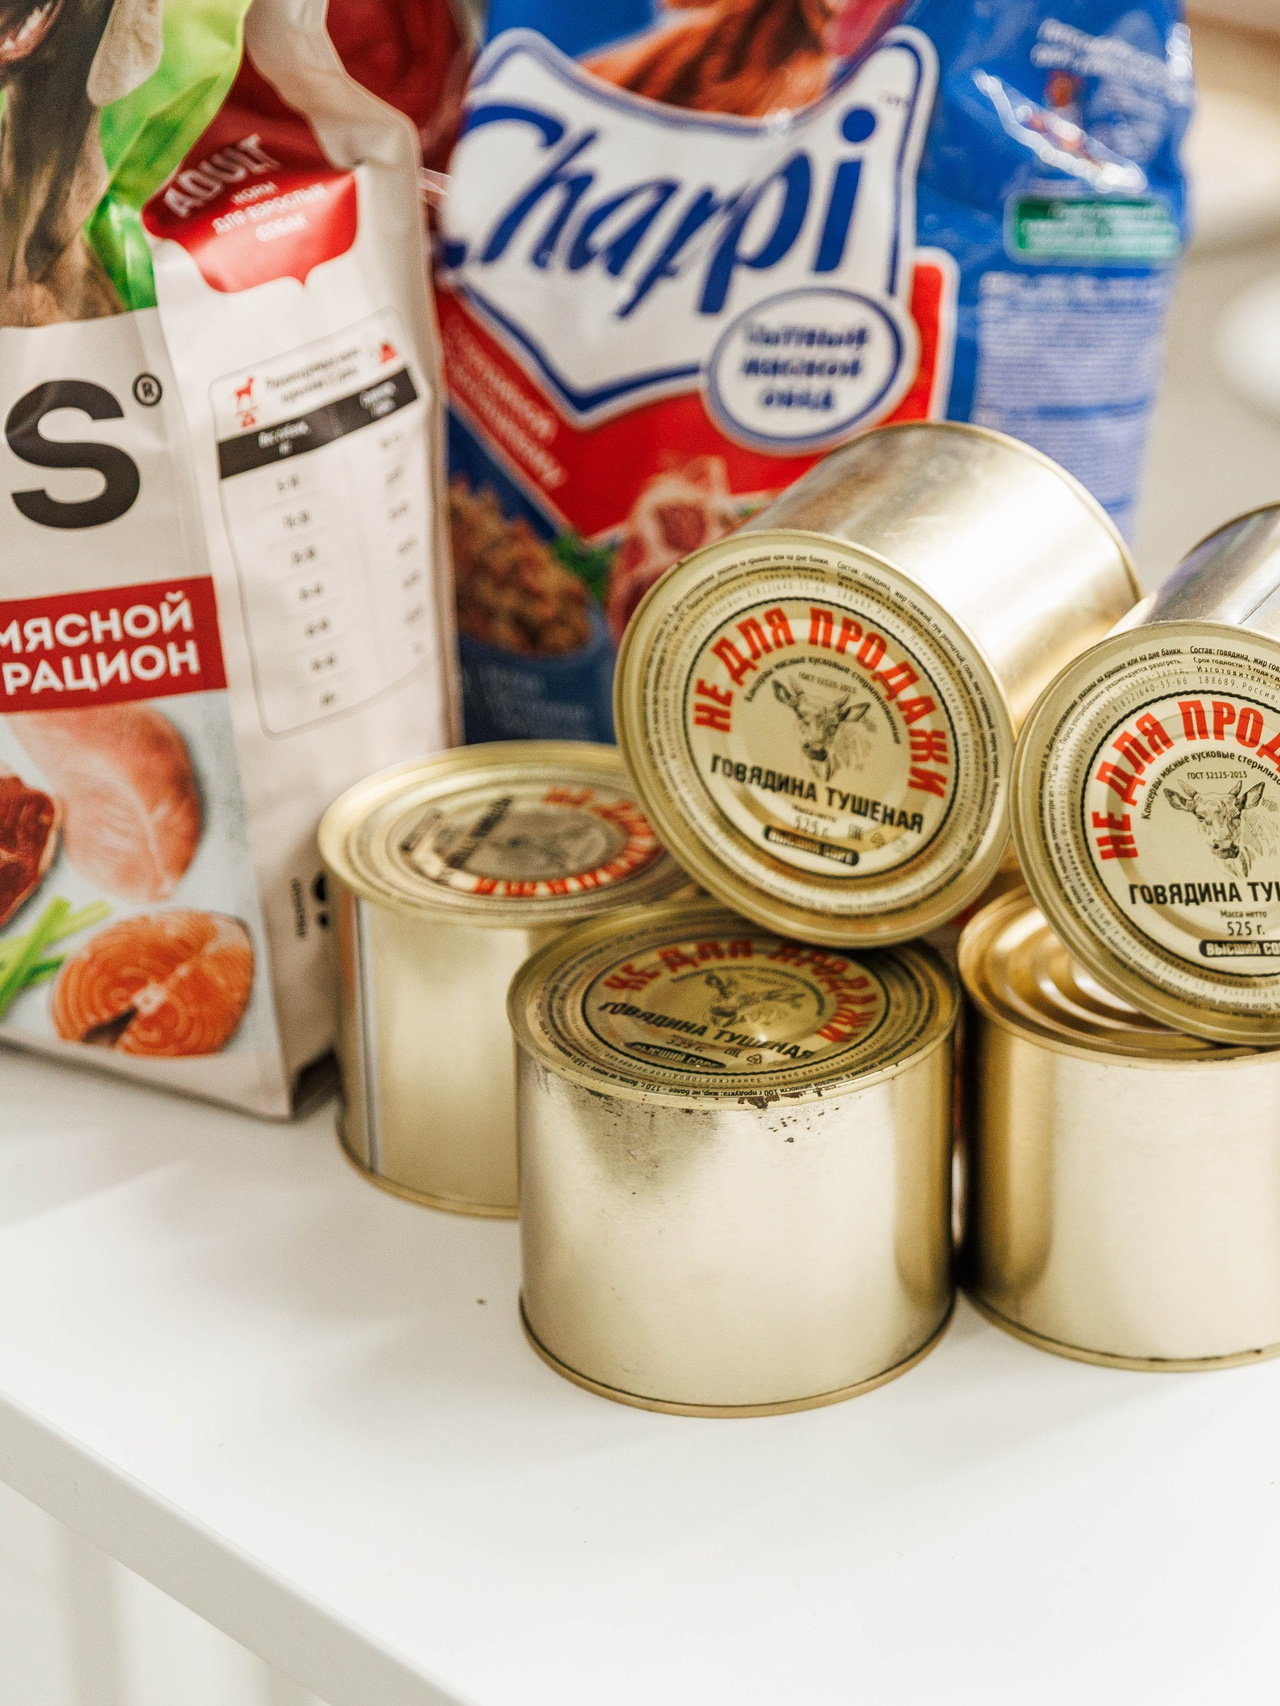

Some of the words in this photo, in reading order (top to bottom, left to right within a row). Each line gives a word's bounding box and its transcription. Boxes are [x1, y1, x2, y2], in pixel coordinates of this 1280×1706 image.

[0, 591, 194, 655] МЯСНОЙ
[712, 606, 796, 686] ДЛЯ
[1188, 645, 1215, 654] Состав:
[1216, 648, 1250, 662] говядина,
[1252, 656, 1267, 668] жир
[2, 640, 199, 696] РАЦИОН
[1101, 661, 1128, 680] крышке
[1125, 657, 1138, 666] или
[1137, 653, 1147, 661] на
[1146, 650, 1161, 660] дне
[1159, 645, 1183, 656] банки.
[1147, 658, 1183, 671] разогреть.
[1192, 656, 1209, 664] Срок
[1211, 658, 1245, 669] годности:
[1253, 667, 1269, 677] года
[1196, 665, 1272, 688] Изготовитель:
[809, 605, 949, 799] ПРОДАЖИ
[1110, 676, 1188, 714] 8(812)640-35-66
[1197, 675, 1239, 689] 188689,
[1241, 681, 1280, 704] Россия,
[693, 677, 734, 734] НЕ
[1094, 711, 1175, 807] ДЛЯ
[1140, 777, 1163, 821] Консервы
[1160, 755, 1191, 779] мясные
[1191, 749, 1236, 762] кусковые
[1186, 770, 1205, 781] ГОСТ
[710, 753, 818, 803] ГОВЯДИНА
[826, 786, 925, 834] ТУШЕНАЯ
[1091, 809, 1140, 861] НЕ
[1128, 881, 1243, 907] ГОВЯДИНА
[1219, 909, 1245, 919] Масса
[1244, 909, 1268, 919] нетто
[1226, 921, 1251, 937] 525
[1205, 940, 1262, 956] ВЫСШИЙ
[597, 1001, 709, 1037] ГОВЯДИНА
[712, 1029, 815, 1060] ТУШЕНАЯ
[668, 1087, 691, 1096] более
[701, 1089, 719, 1097] жир,
[720, 1090, 758, 1098] продукта:
